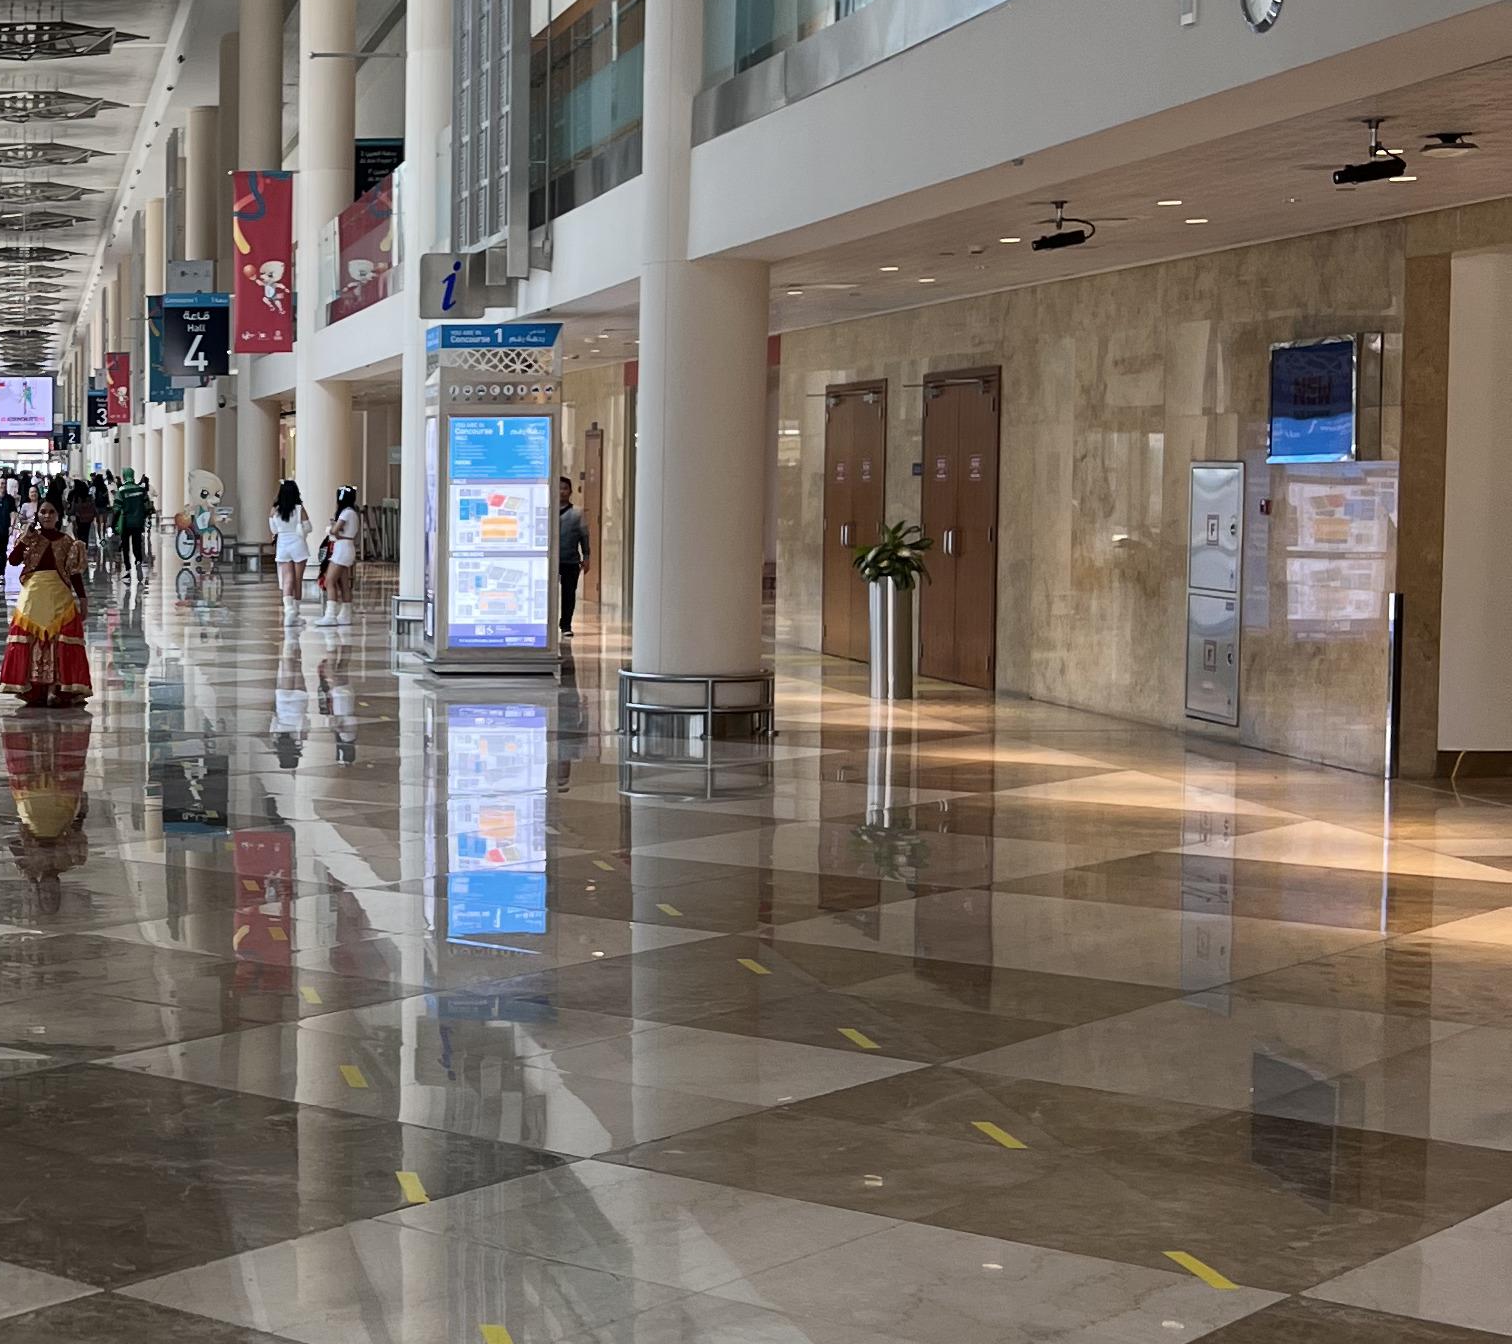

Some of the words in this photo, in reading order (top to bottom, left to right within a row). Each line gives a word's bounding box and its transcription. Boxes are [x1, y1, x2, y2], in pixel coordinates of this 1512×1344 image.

[187, 323, 206, 332] Hall
[450, 335, 491, 344] Concourse
[494, 328, 503, 343] 1
[184, 335, 208, 372] 4
[96, 408, 108, 426] 3
[497, 420, 505, 436] 1
[68, 432, 76, 444] 2
